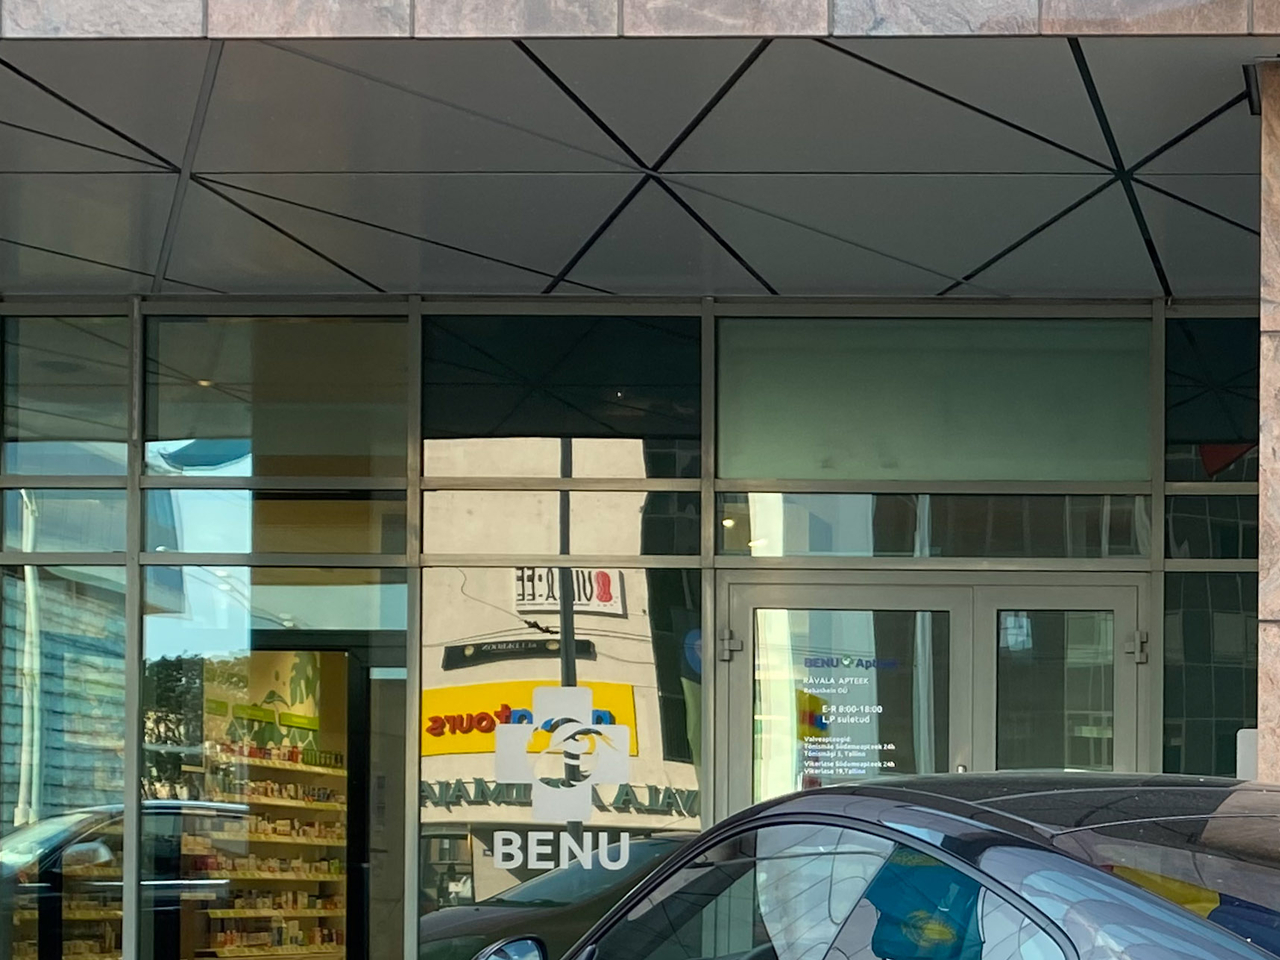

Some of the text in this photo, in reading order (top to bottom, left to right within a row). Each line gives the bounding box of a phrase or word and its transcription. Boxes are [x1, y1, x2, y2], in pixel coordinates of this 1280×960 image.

[804, 657, 839, 668] BENU
[803, 675, 835, 684] RÄVALA
[822, 705, 837, 713] E-R
[837, 715, 870, 723] suletud
[493, 831, 630, 870] BENU
